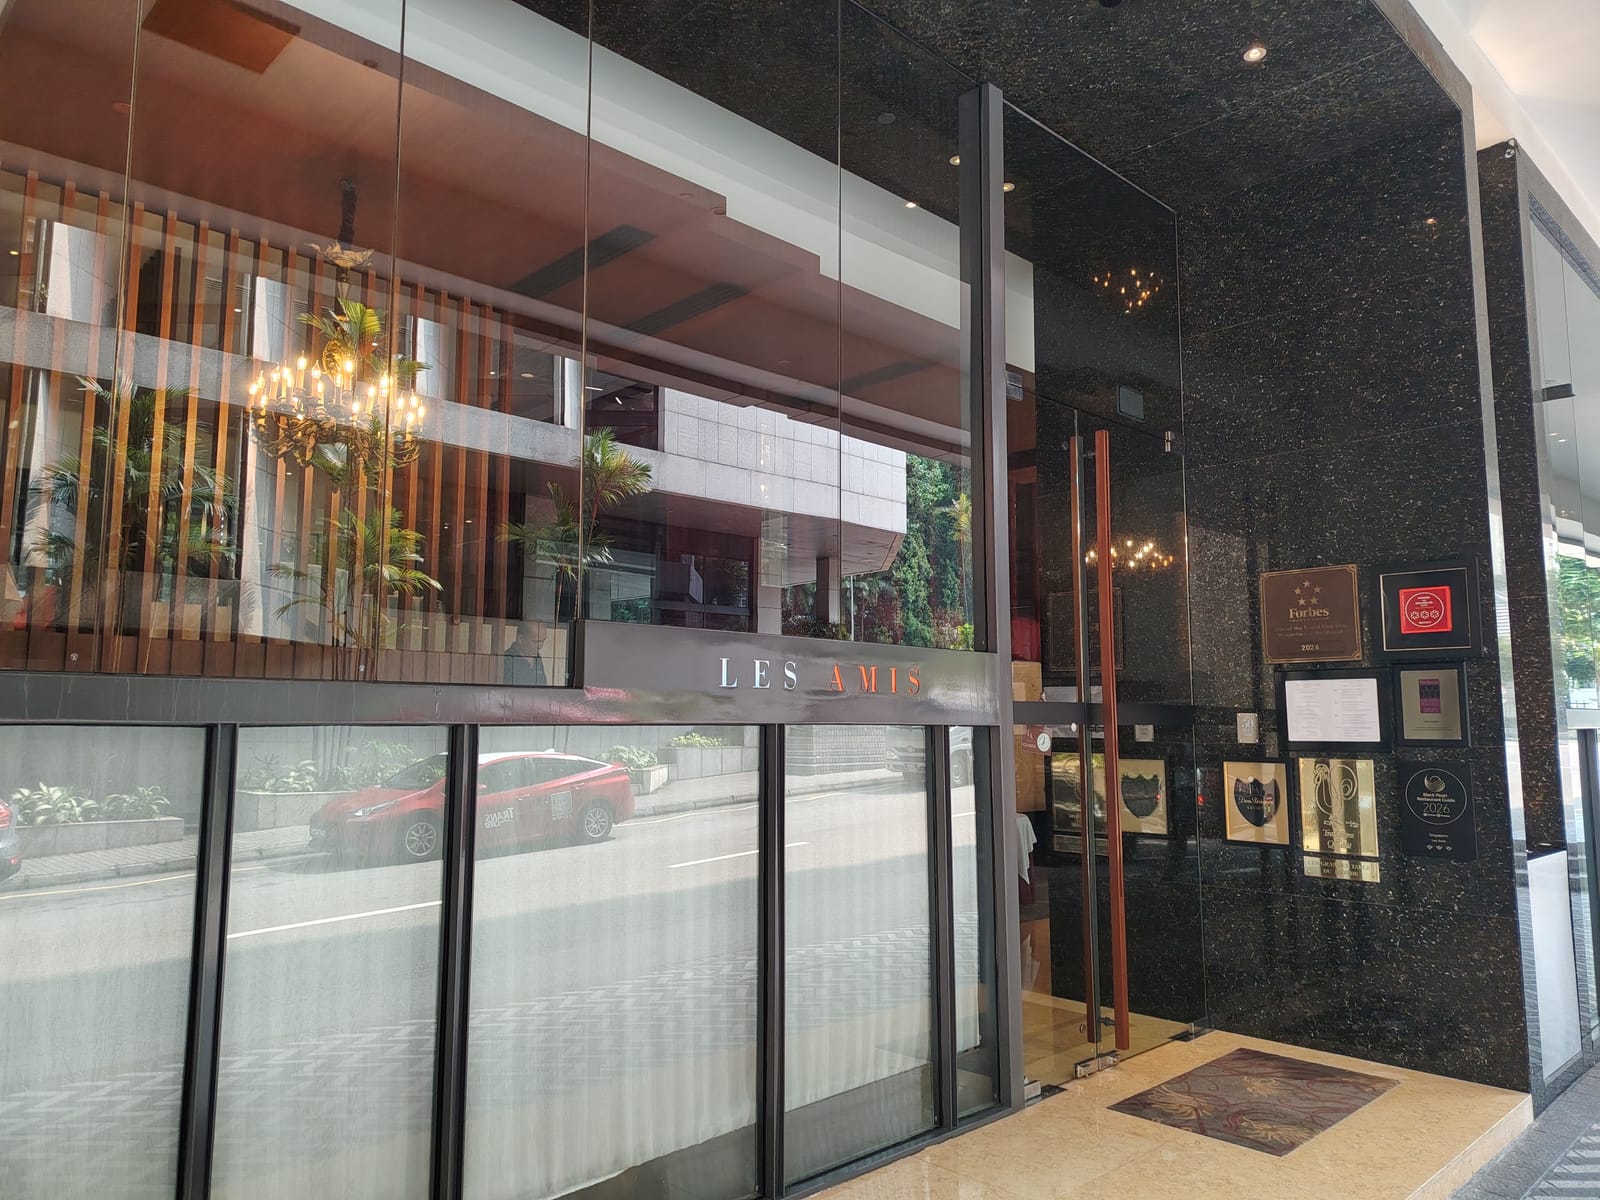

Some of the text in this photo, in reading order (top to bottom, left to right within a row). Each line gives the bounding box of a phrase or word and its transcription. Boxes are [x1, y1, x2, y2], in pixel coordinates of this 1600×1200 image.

[1289, 607, 1329, 619] Forbes
[719, 657, 921, 695] LES AMIS
[1423, 802, 1451, 814] 2026
